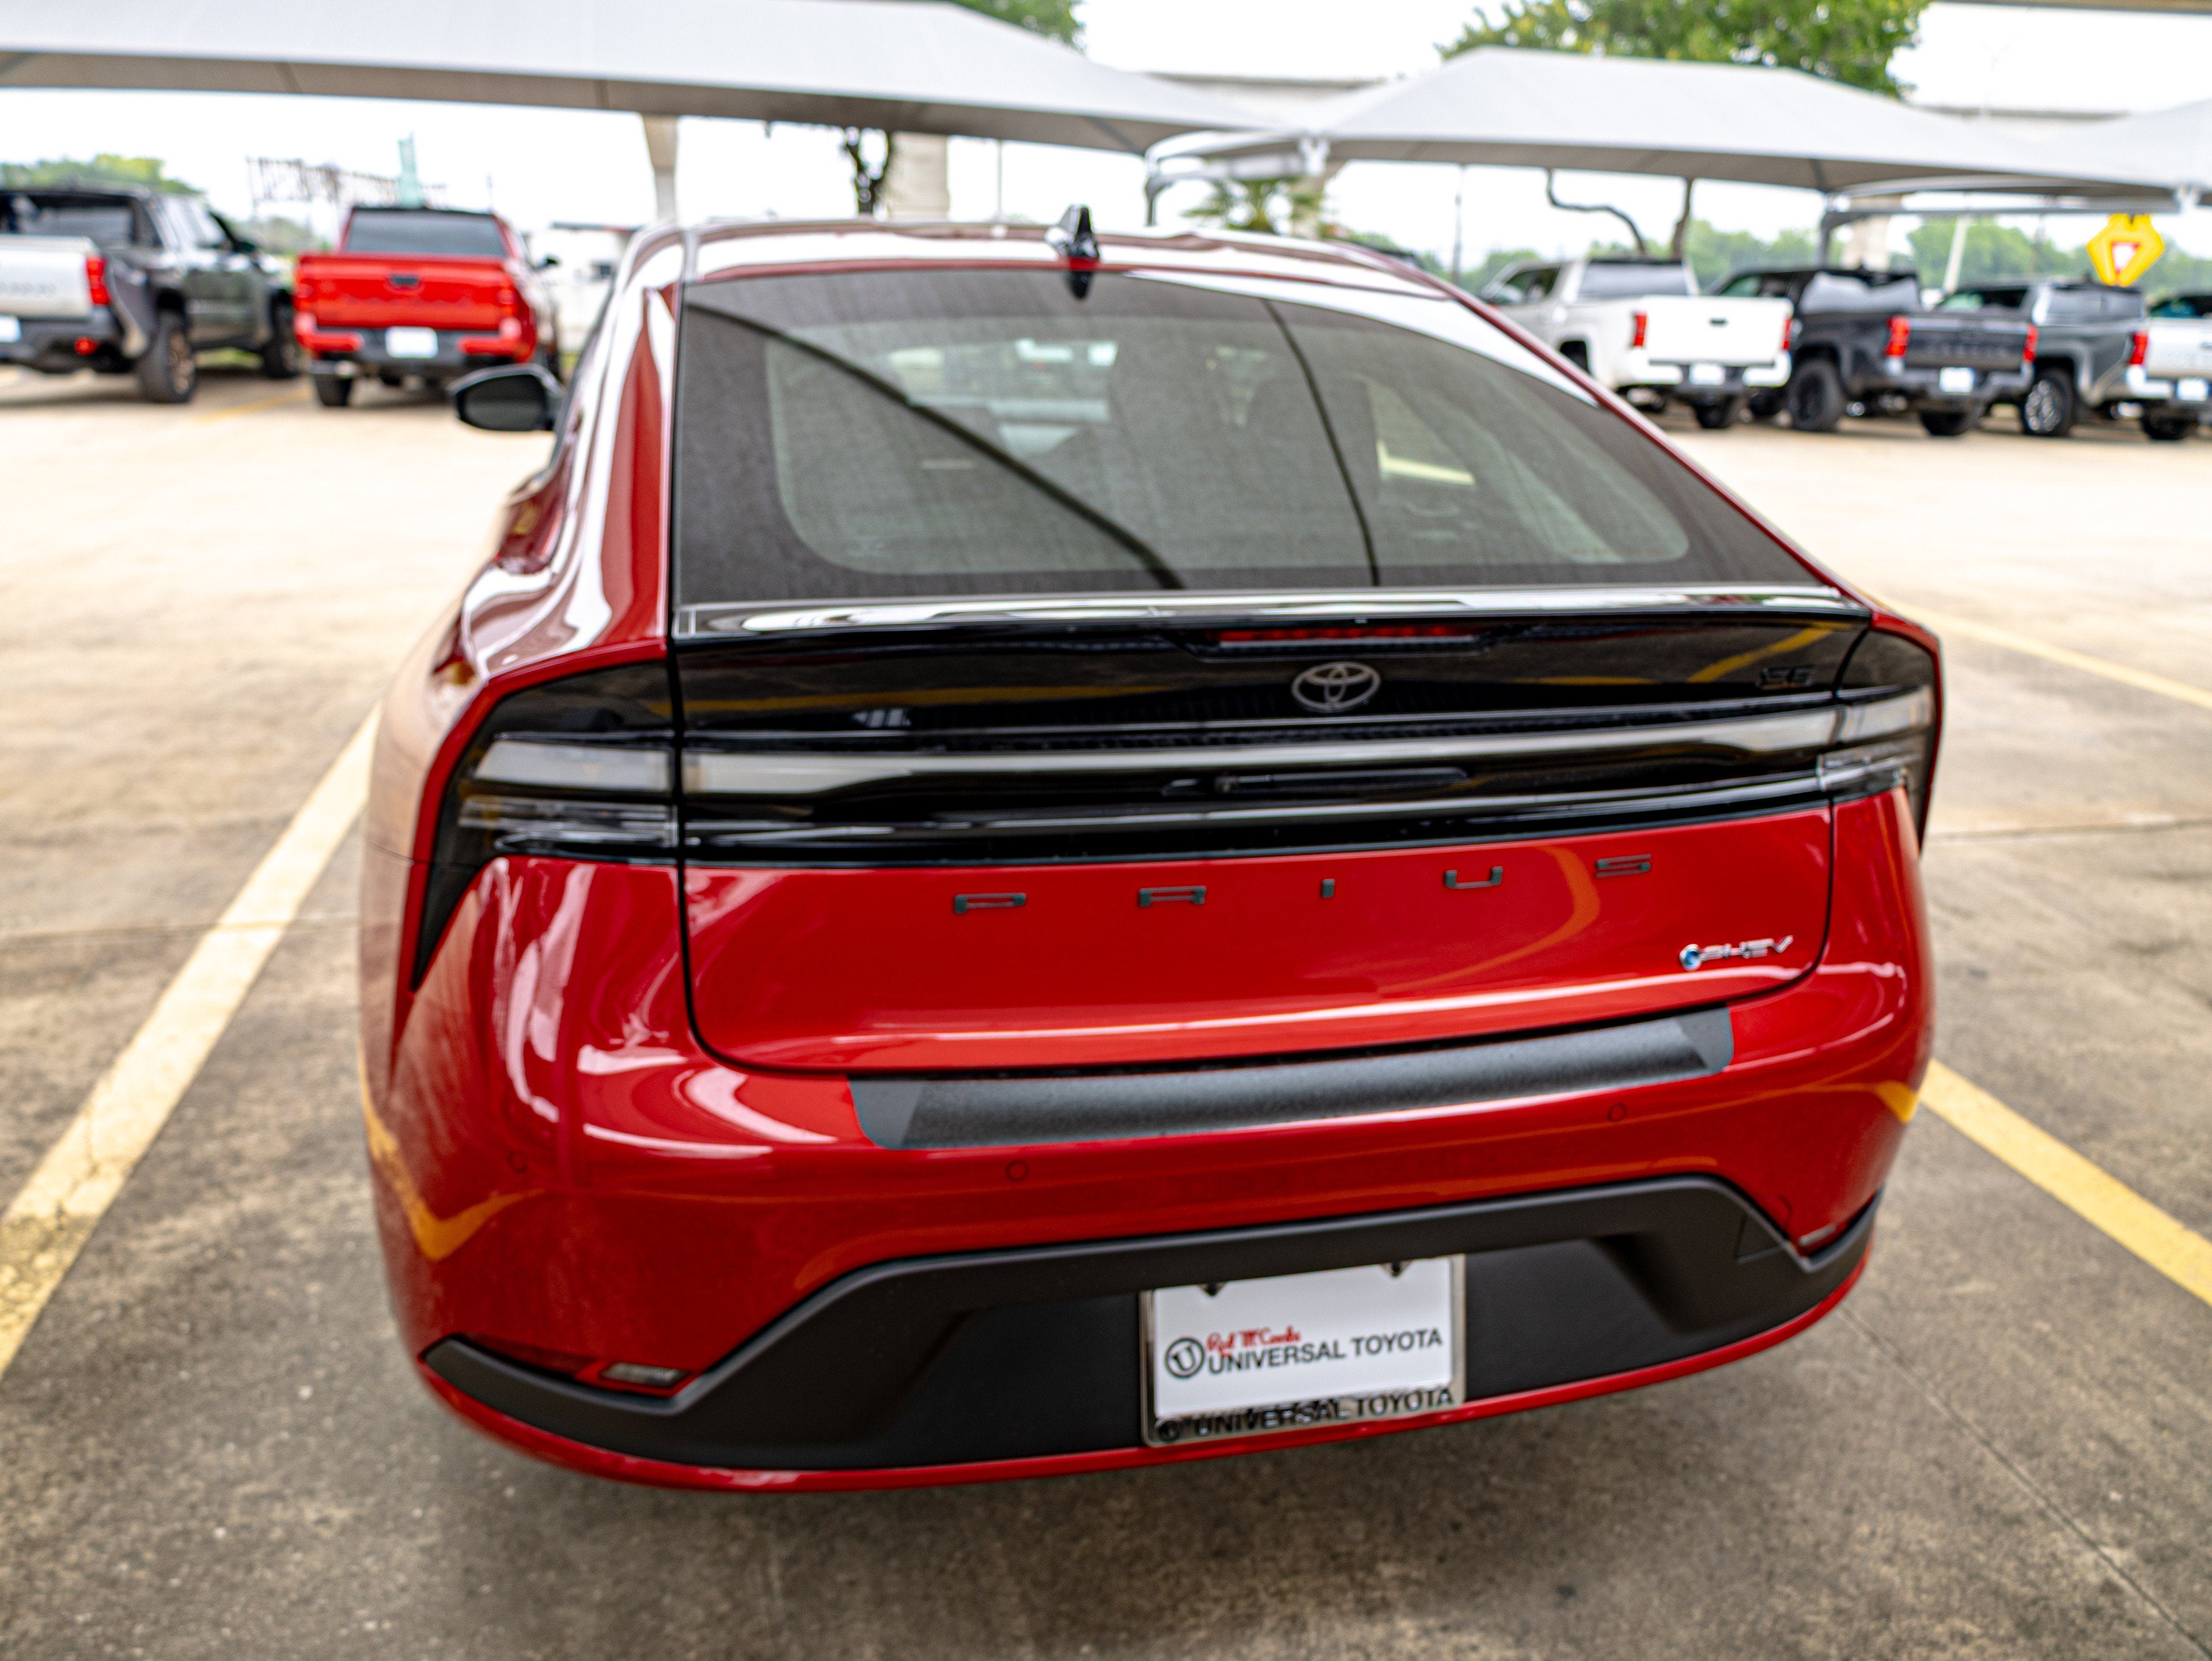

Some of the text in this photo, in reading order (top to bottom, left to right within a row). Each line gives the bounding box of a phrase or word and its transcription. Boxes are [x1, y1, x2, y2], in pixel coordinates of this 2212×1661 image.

[955, 853, 1652, 914] PRIUS
[1209, 1340, 1347, 1375] UNIVERSAL
[1351, 1327, 1442, 1357] TOYOTA
[1194, 1396, 1351, 1436] UNIVERSAL
[1354, 1384, 1454, 1417] TOYOTA
